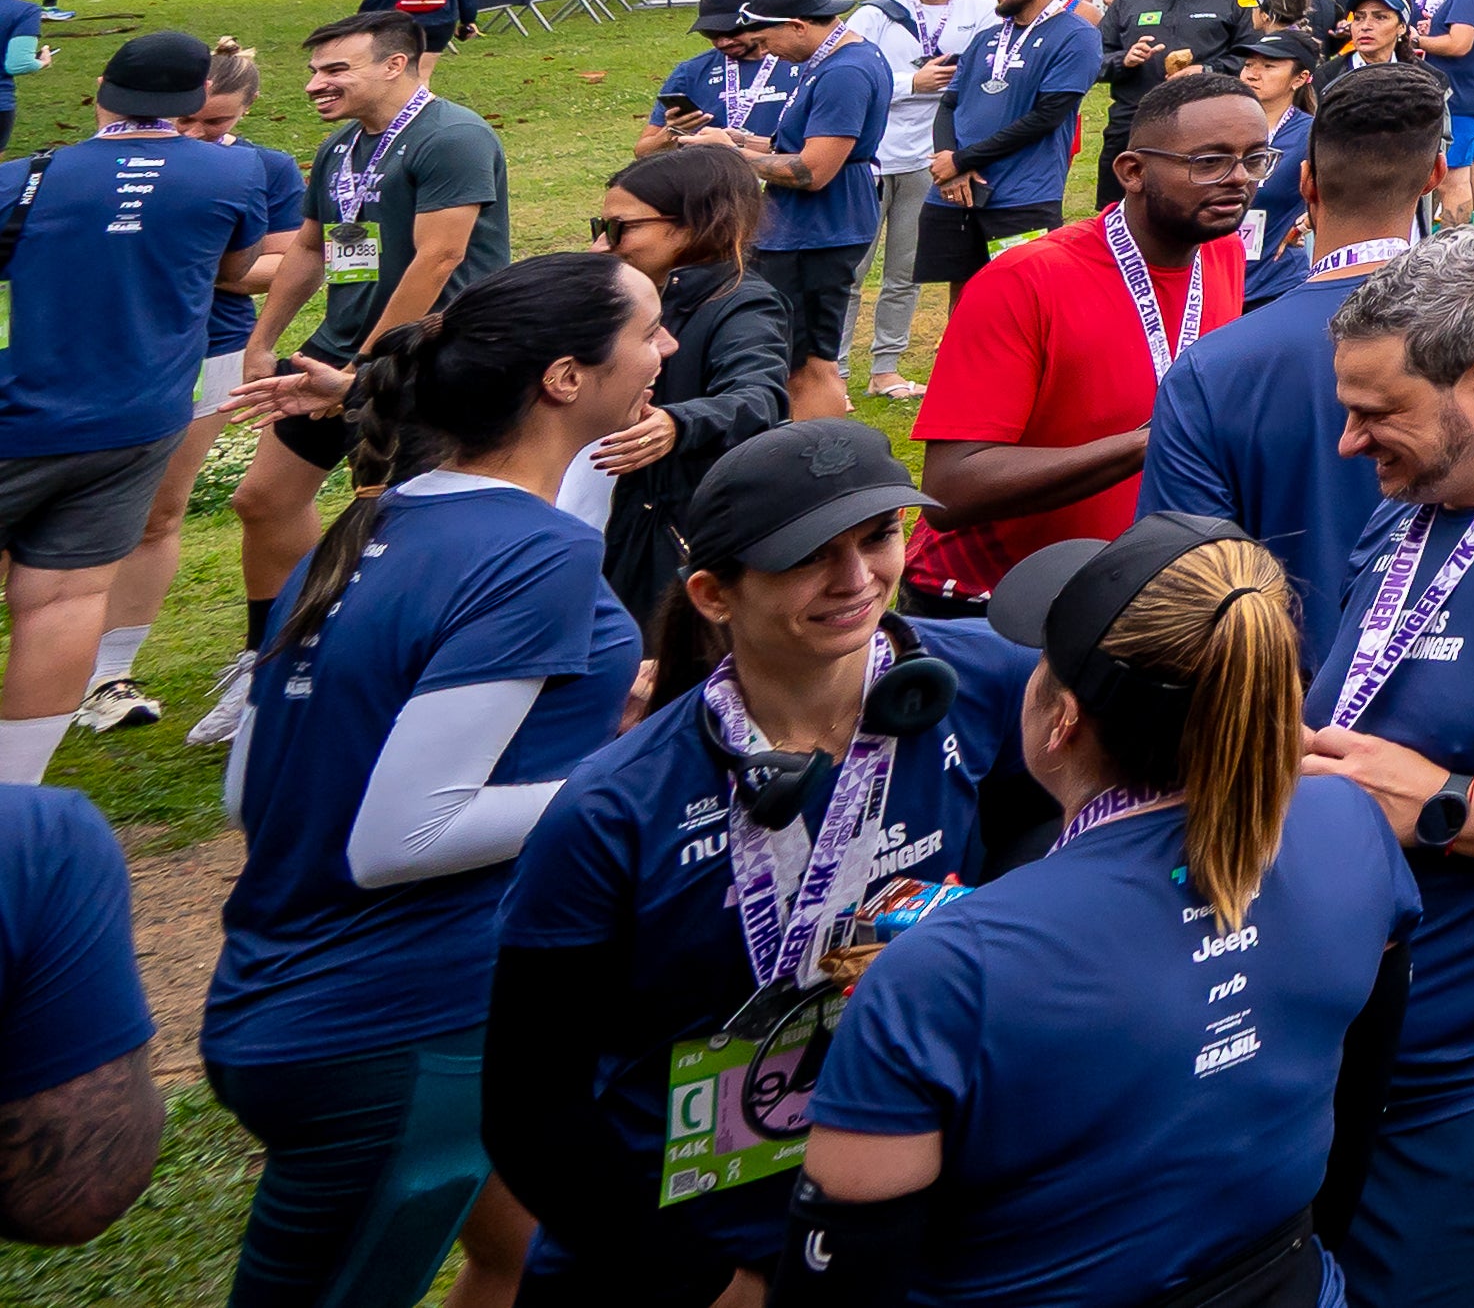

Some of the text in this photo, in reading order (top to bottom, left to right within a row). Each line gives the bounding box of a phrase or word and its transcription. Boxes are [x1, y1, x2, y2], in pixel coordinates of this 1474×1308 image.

[1180, 293, 1202, 351] THENAS
[1337, 680, 1380, 725] RUN
[1373, 585, 1446, 685] LONGER
[865, 829, 943, 883] ONGER
[799, 862, 838, 909] 14K
[1192, 924, 1259, 963] Jeep
[683, 1086, 704, 1130] C
[668, 1140, 709, 1162] 14K
